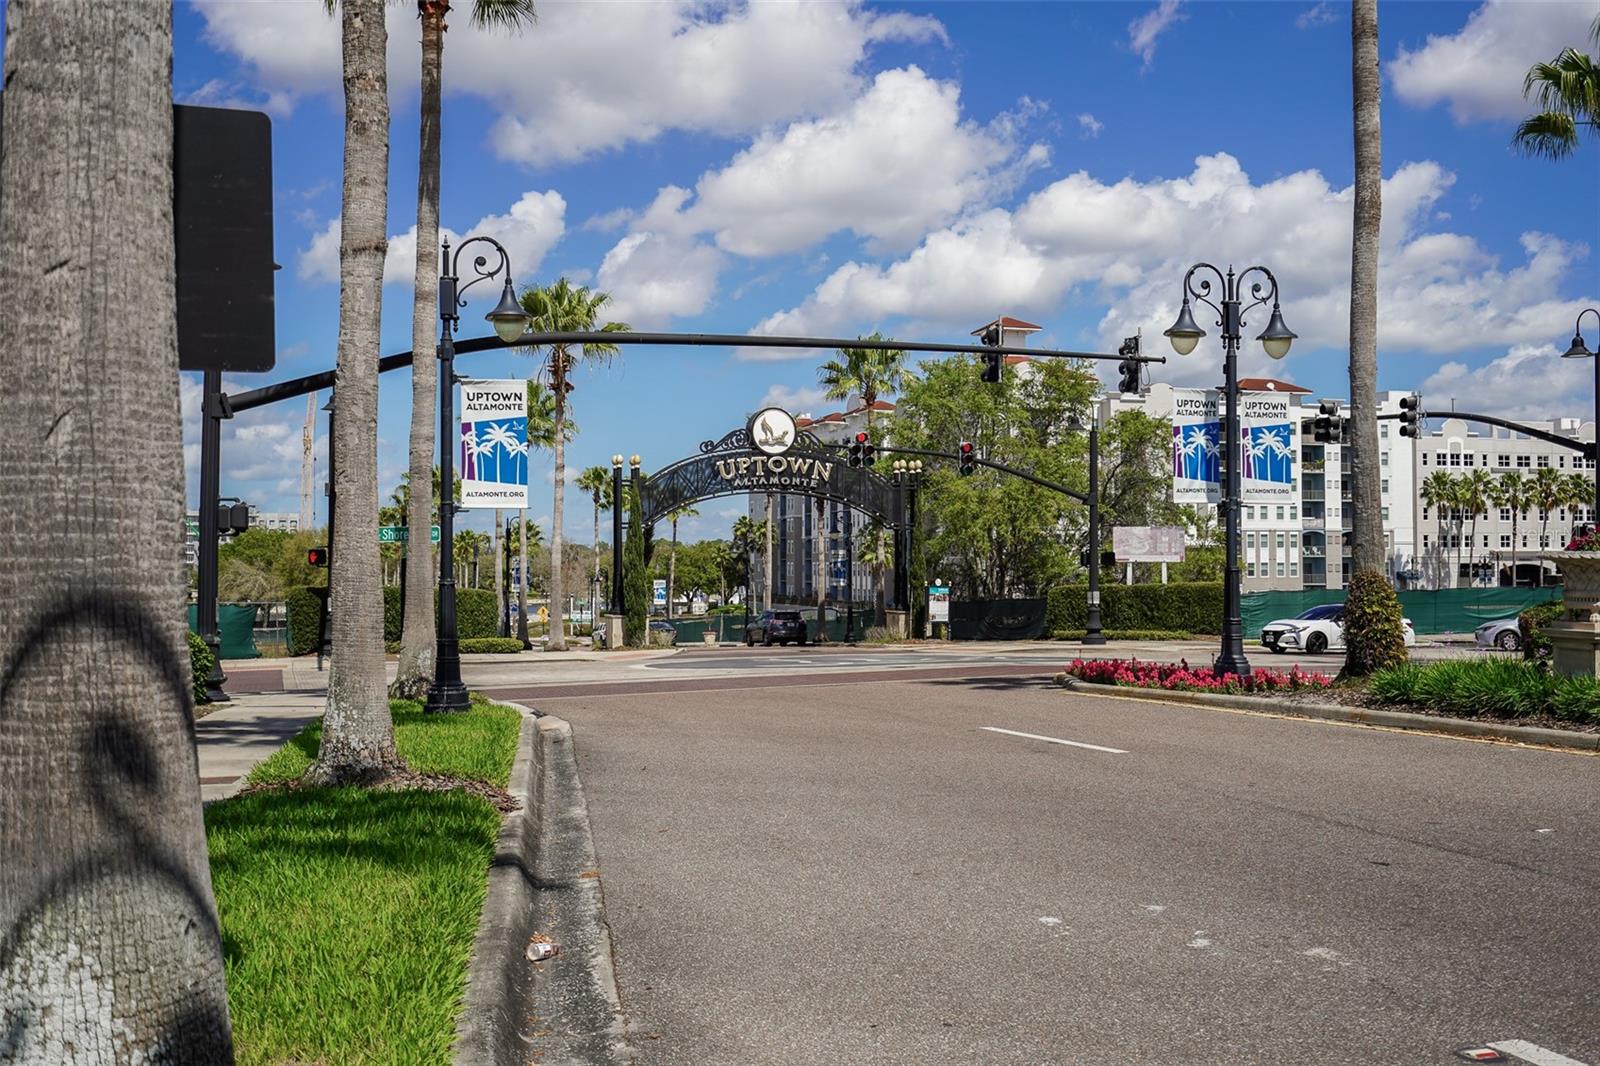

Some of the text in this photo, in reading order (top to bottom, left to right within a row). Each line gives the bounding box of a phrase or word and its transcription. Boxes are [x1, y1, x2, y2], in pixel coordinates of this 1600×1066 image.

[466, 392, 523, 402] UPTOWN
[465, 403, 524, 411] ALTAMONTE
[1176, 399, 1217, 410] UPTOWN
[1244, 401, 1287, 411] UPTOWN
[1176, 409, 1217, 417] ALTAMONTE
[1244, 411, 1288, 419] ALTAMONTE
[715, 455, 834, 482] UPTOWN
[733, 476, 819, 488] ALTAMONTE
[382, 528, 409, 540] Shore
